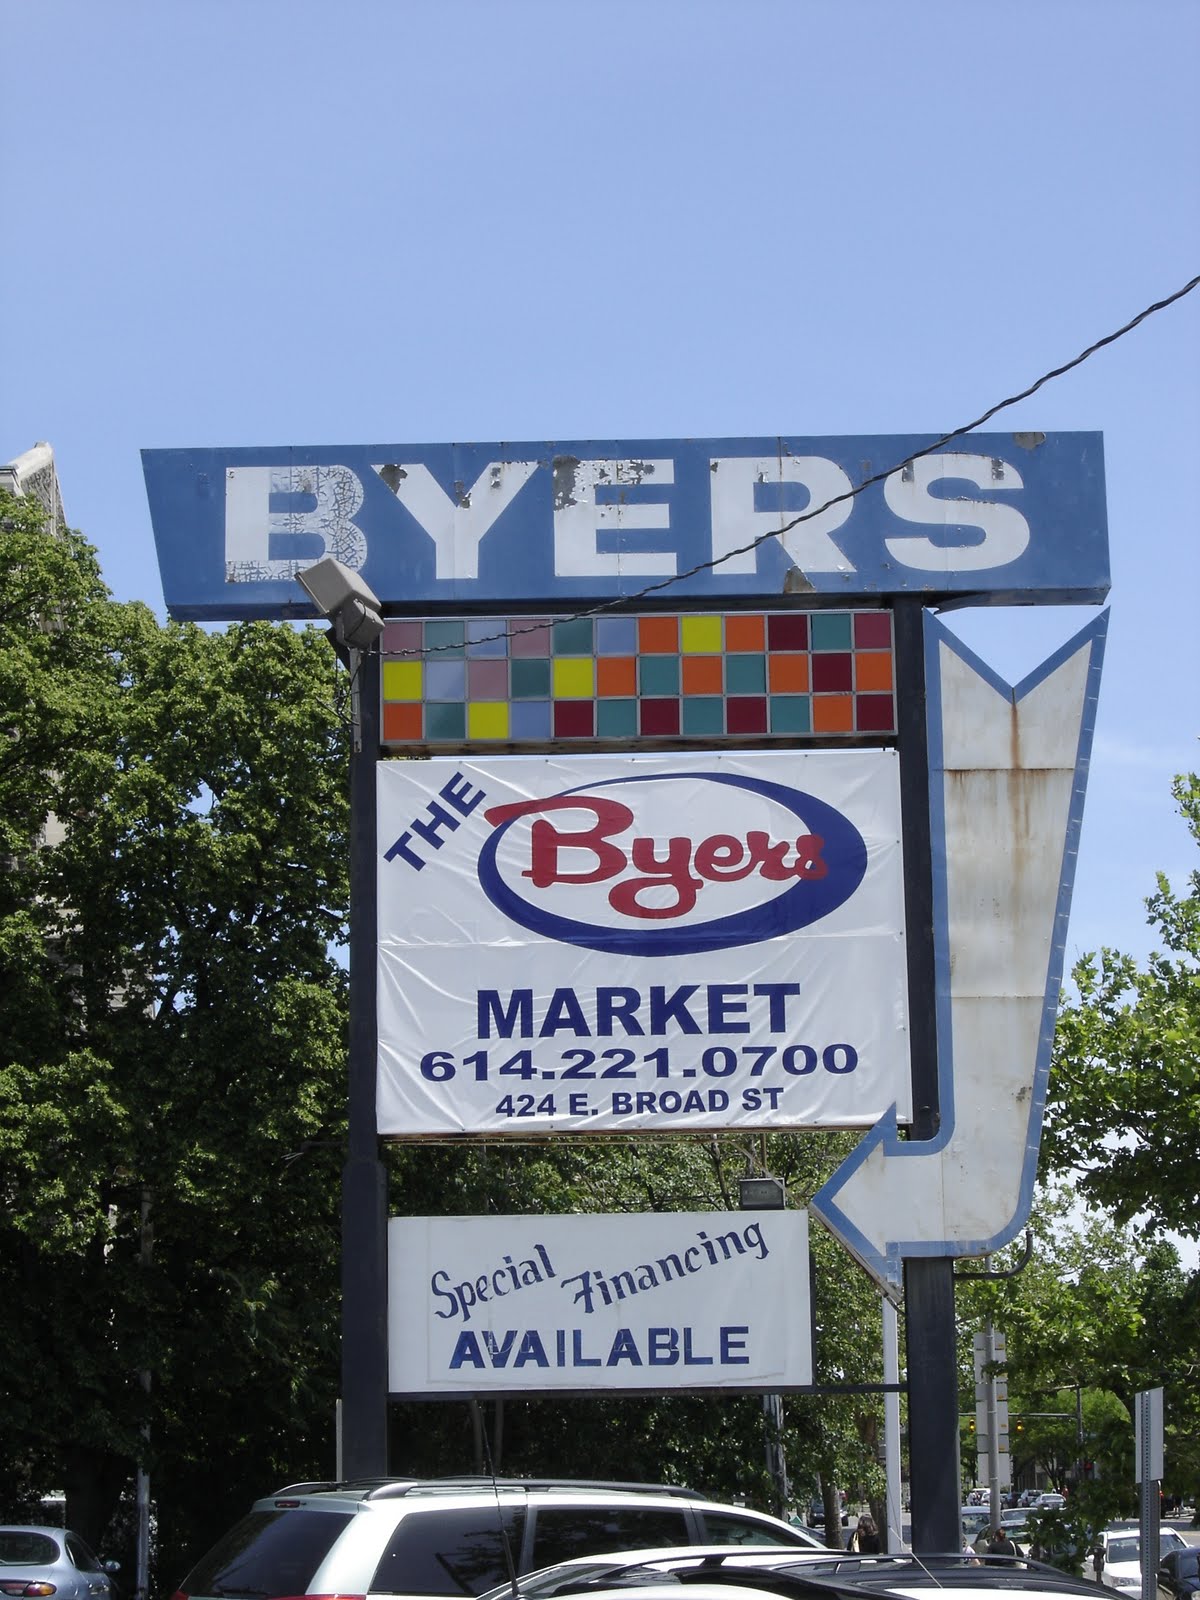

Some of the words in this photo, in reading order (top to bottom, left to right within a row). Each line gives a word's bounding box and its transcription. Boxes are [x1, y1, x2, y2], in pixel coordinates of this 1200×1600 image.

[225, 453, 1030, 583] BYERS
[383, 771, 487, 872] THE
[484, 796, 829, 919] Byers
[477, 983, 801, 1039] MARKET
[419, 1043, 859, 1082] 614.221.0700
[495, 1093, 557, 1118] 424
[569, 1092, 599, 1116] E.
[612, 1089, 730, 1115] BROAD
[742, 1087, 785, 1111] ST
[431, 1244, 558, 1322] Special
[560, 1222, 770, 1314] Financing
[448, 1326, 750, 1369] AVAILABLE
